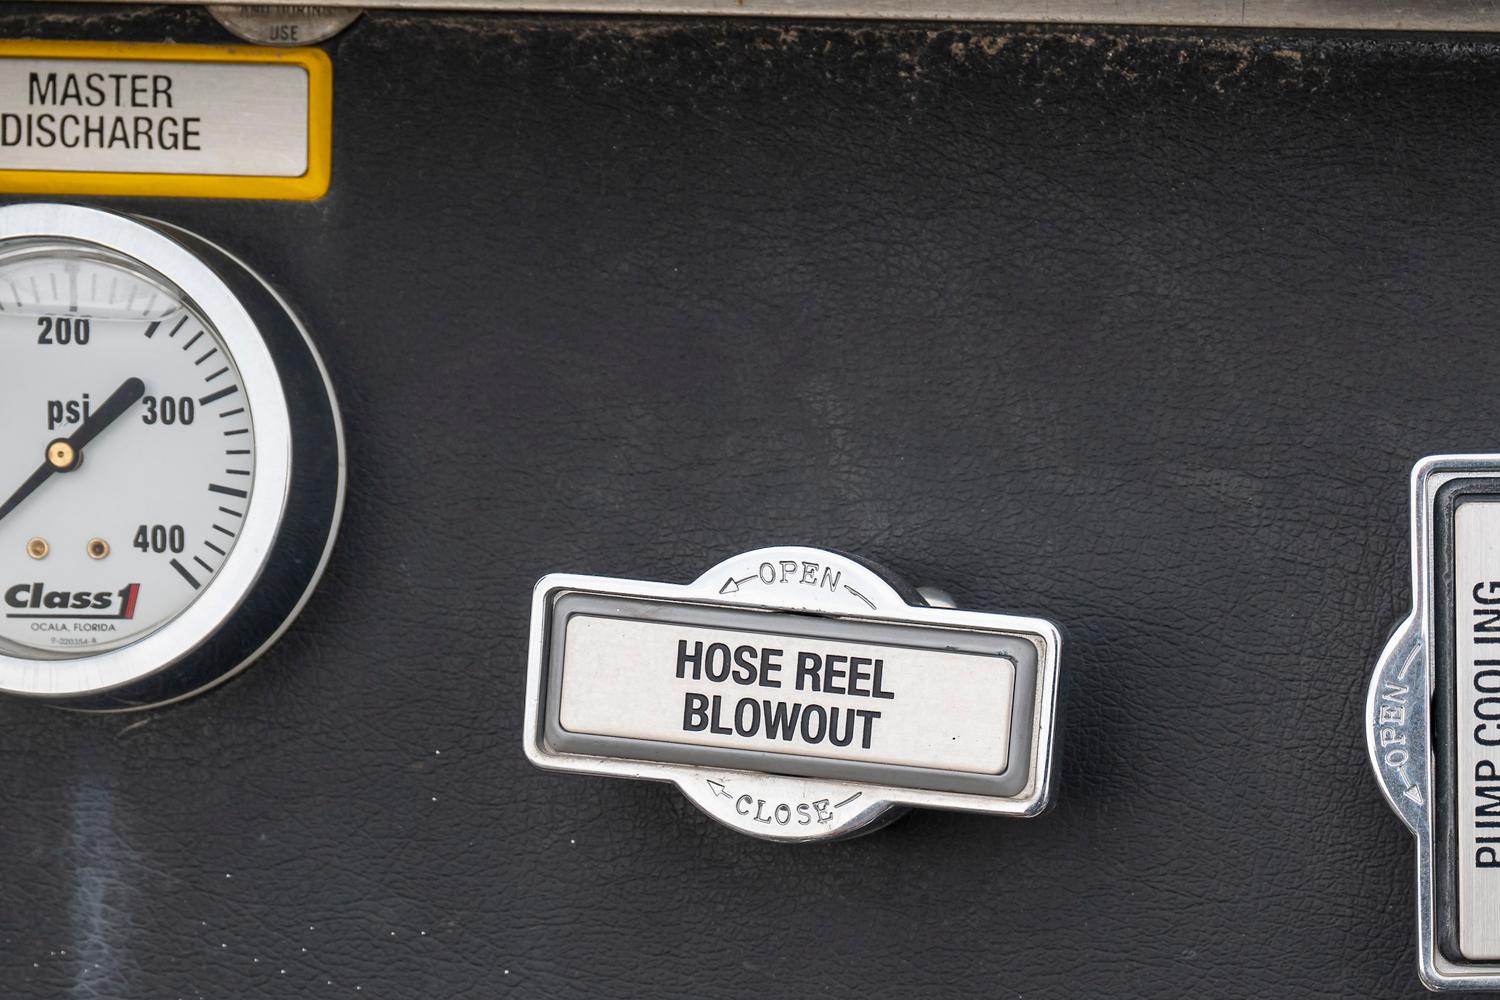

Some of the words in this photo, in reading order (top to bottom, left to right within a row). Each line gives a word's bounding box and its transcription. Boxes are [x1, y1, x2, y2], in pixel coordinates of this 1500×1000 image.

[270, 25, 298, 41] USE
[28, 72, 173, 108] MASTER
[1, 113, 201, 150] DISCHARGE
[37, 316, 90, 345] 200
[47, 393, 89, 429] psi
[142, 396, 194, 425] 300
[133, 524, 185, 553] 400
[758, 561, 841, 592] OPEN
[30, 622, 71, 632] OCALA,
[73, 623, 117, 632] FLORIDA
[675, 639, 782, 689] HOSE
[795, 651, 895, 700] REEL
[682, 692, 882, 750] BLOWOUT
[1378, 681, 1410, 768] OPEN
[735, 795, 835, 825] CLOSE
